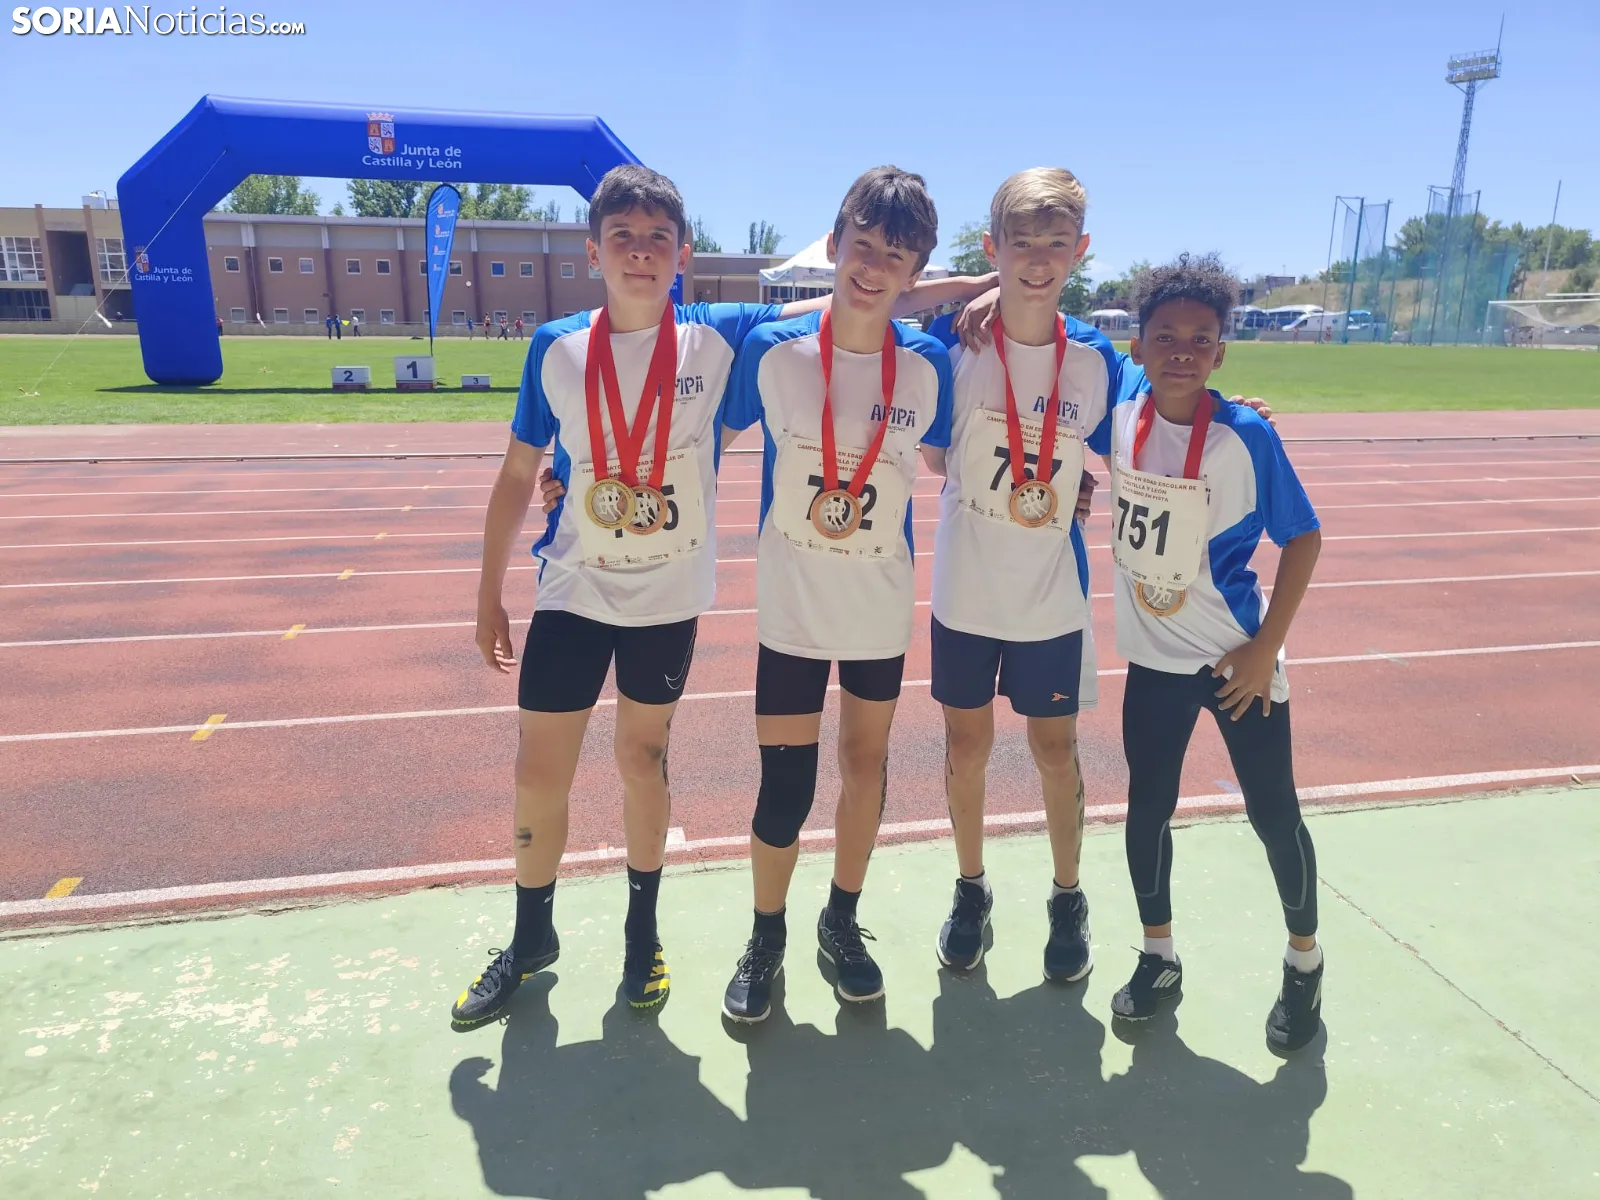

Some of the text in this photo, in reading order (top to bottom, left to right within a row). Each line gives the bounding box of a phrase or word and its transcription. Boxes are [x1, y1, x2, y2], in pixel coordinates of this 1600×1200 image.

[400, 143, 462, 157] Junta de
[361, 155, 462, 170] Castilla y León
[153, 266, 193, 275] Junta de
[134, 273, 193, 283] Castilla y León
[406, 360, 418, 379] 1
[343, 370, 354, 382] 2
[472, 377, 479, 385] 3
[1158, 481, 1187, 490] ESCOLAR
[1117, 496, 1171, 556] 751
